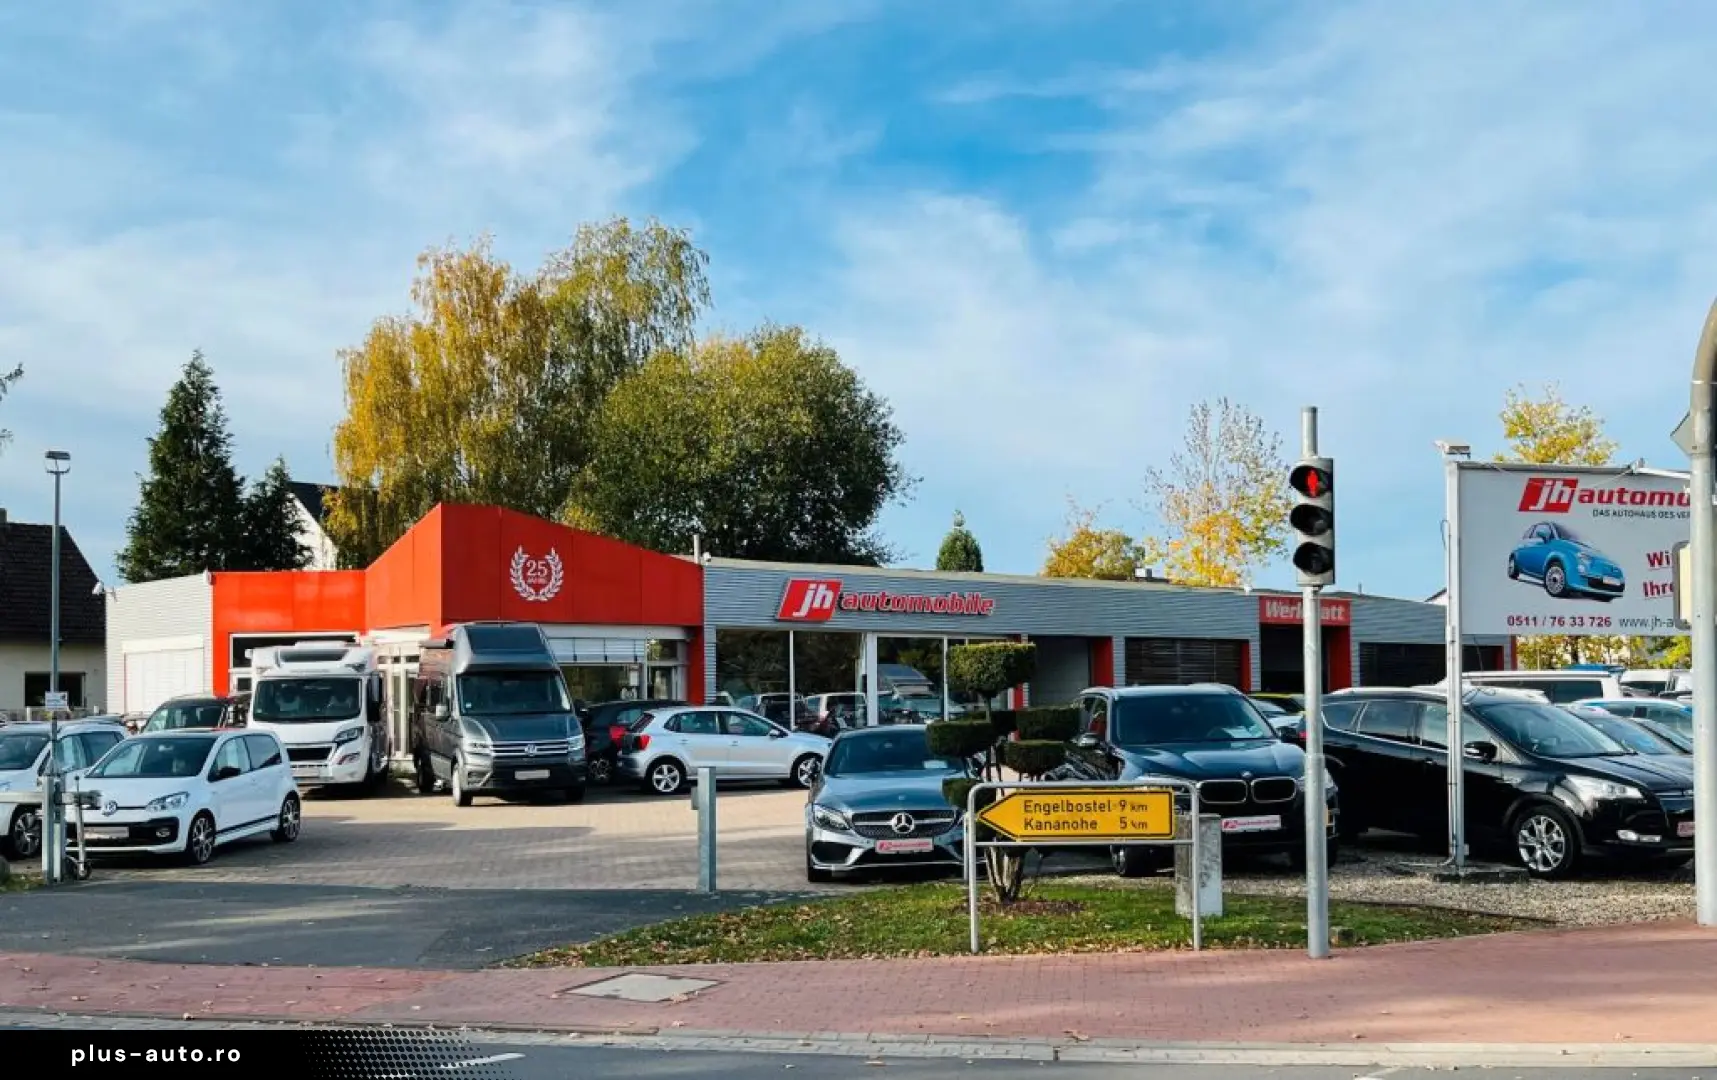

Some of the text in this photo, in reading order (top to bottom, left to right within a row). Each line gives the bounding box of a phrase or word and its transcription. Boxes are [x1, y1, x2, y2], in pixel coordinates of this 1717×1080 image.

[1529, 480, 1691, 511] jh automo
[1593, 509, 1611, 518] DAS
[1612, 509, 1657, 519] AUTOHAUS
[1658, 511, 1675, 519] DES
[1646, 550, 1671, 567] Wi
[526, 560, 548, 577] 25
[793, 583, 994, 617] jh automobile
[1507, 615, 1538, 627] 0511
[1550, 616, 1565, 627] 76
[1570, 616, 1585, 627] 33
[1589, 616, 1612, 628] 726
[1619, 615, 1674, 631] www.jh-a
[1023, 799, 1148, 816] Engelbostel 9 km
[1023, 817, 1148, 831] Kananohe 5 km
